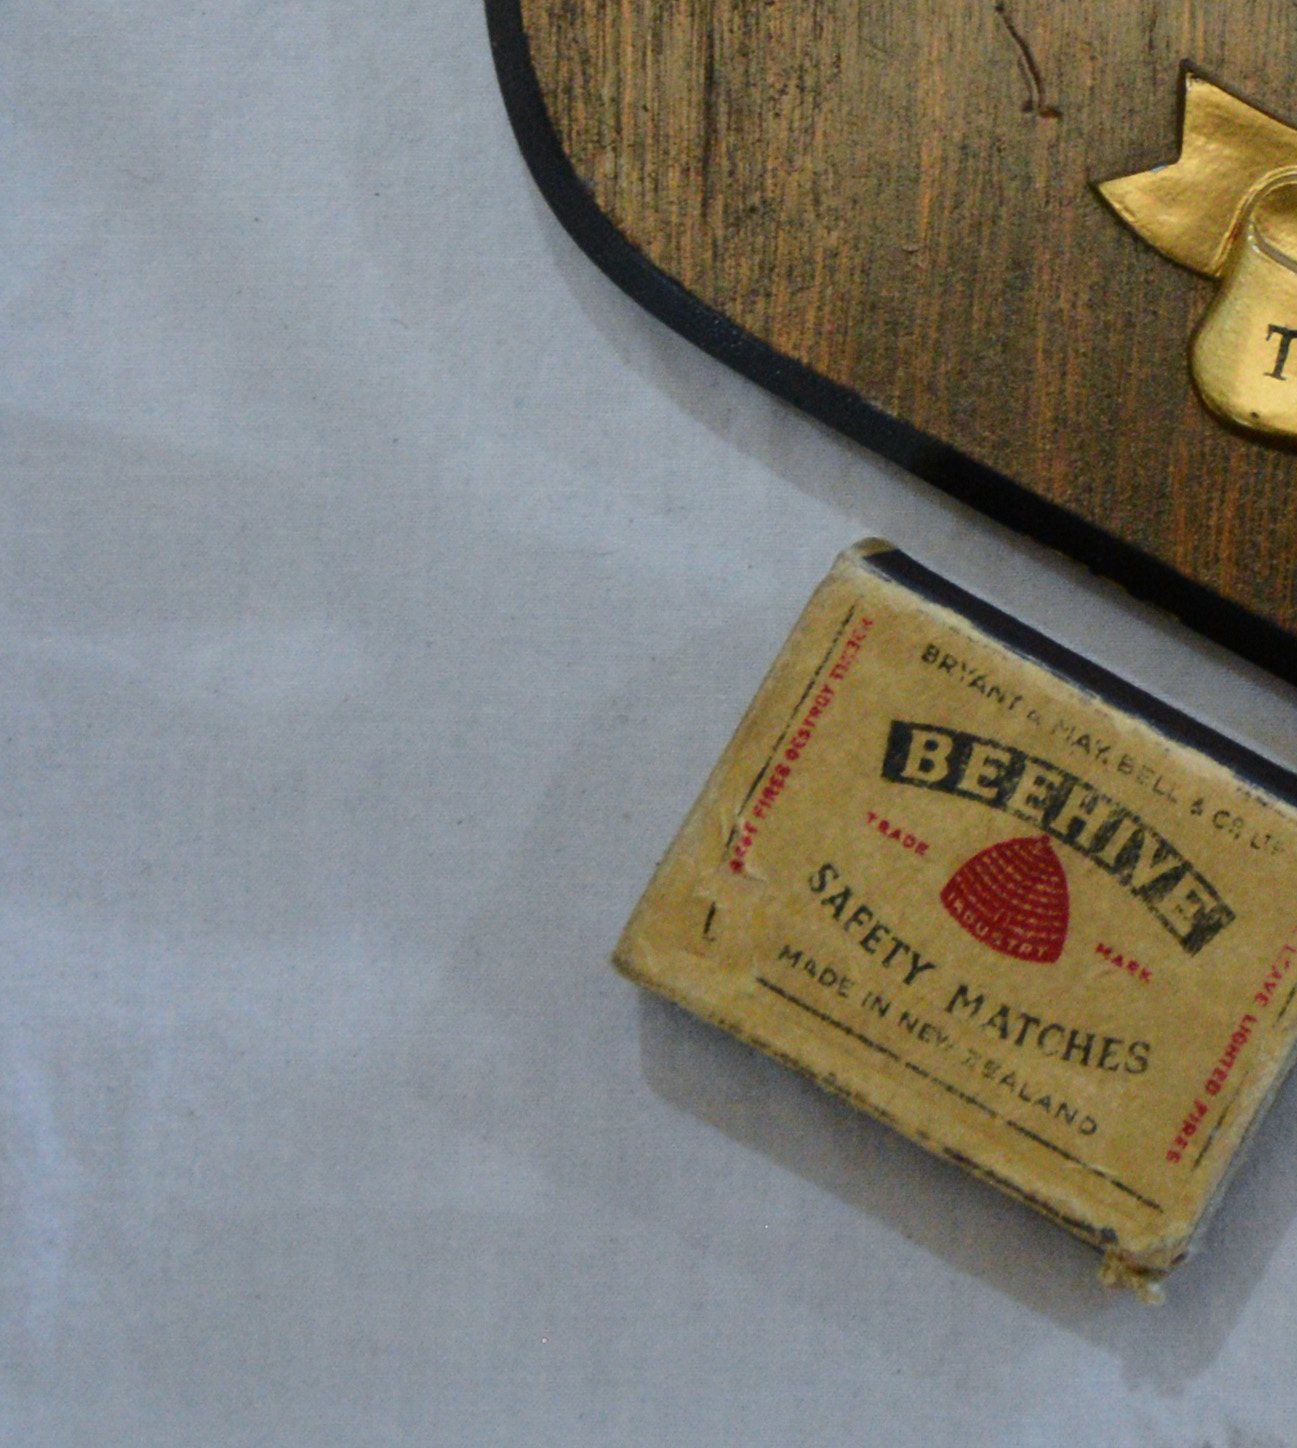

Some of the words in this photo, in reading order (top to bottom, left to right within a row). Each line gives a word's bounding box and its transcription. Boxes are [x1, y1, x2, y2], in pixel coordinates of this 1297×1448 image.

[921, 643, 1023, 710] BRYANT
[1117, 754, 1177, 804] BELL
[866, 810, 930, 856] TRADE
[1095, 942, 1152, 983] MARK
[896, 724, 1222, 946] BEEHIVE
[778, 945, 855, 1000] MADE
[861, 991, 892, 1018] IN
[897, 1011, 957, 1054] NEW
[961, 1048, 1098, 1137] ZEALAND
[808, 862, 937, 987] SAFETY
[944, 984, 1153, 1076] MATCHES
[1204, 1014, 1258, 1097] LIGHTED
[1166, 1099, 1209, 1164] FIRES
